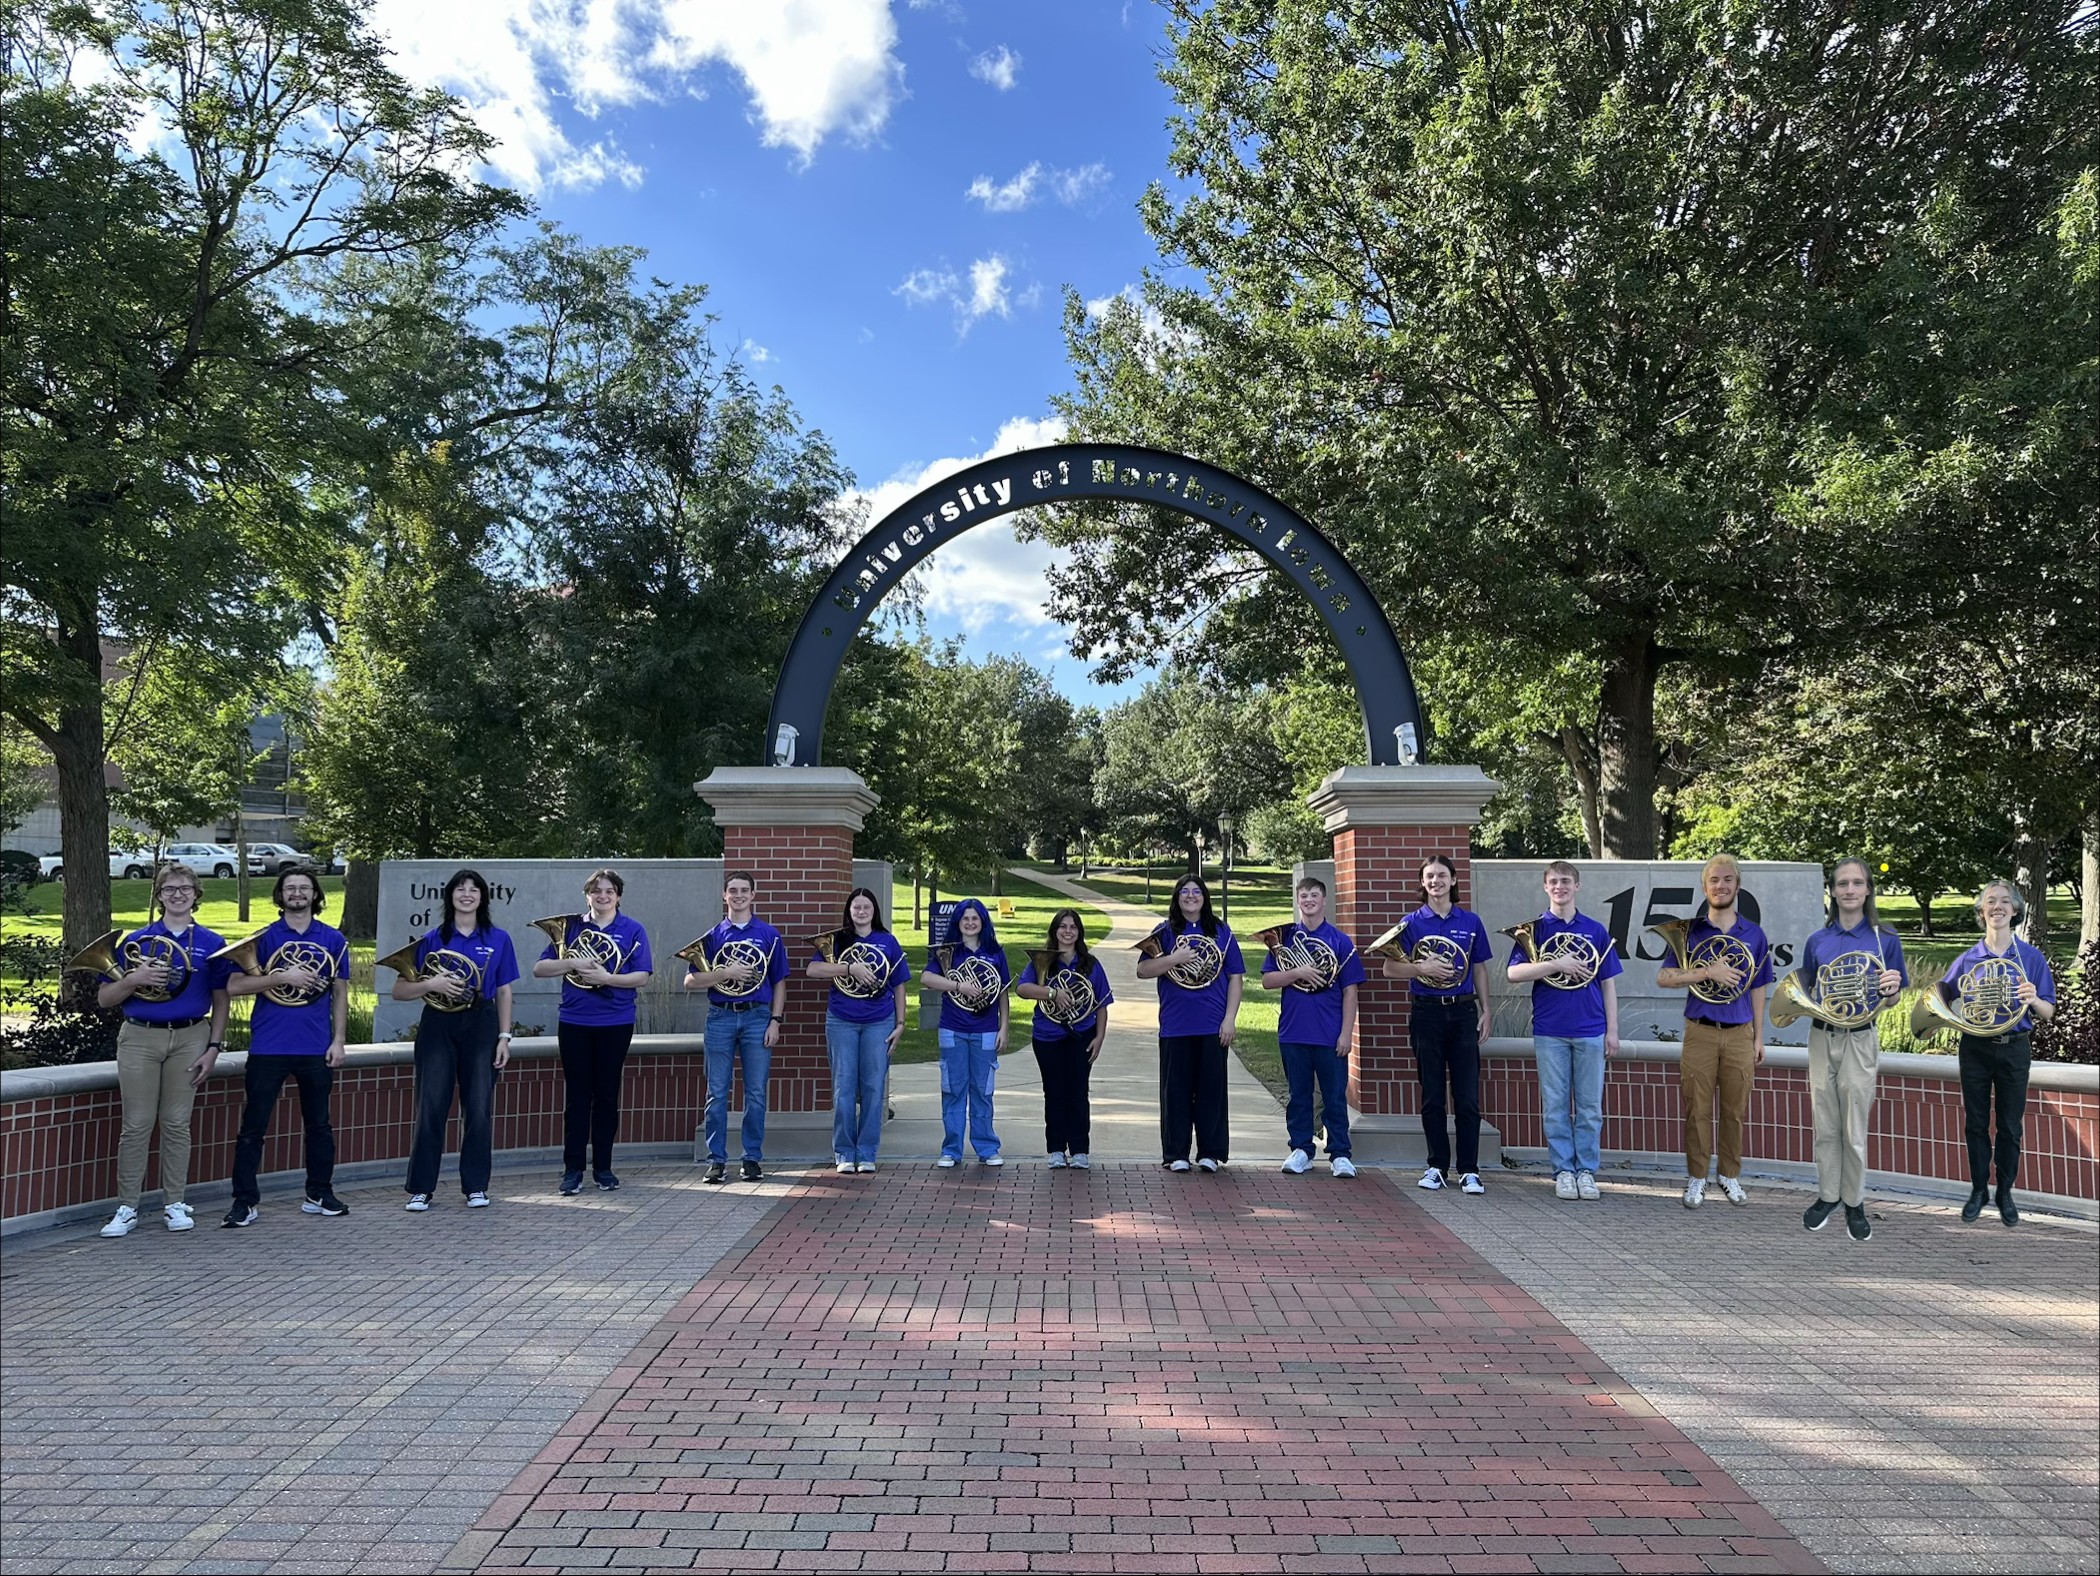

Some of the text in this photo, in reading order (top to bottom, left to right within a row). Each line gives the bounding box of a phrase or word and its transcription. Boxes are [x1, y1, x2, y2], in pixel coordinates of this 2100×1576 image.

[832, 459, 1350, 614] University of Northern Iowa
[411, 882, 516, 905] Uniity
[409, 908, 431, 927] of
[939, 904, 957, 914] UN
